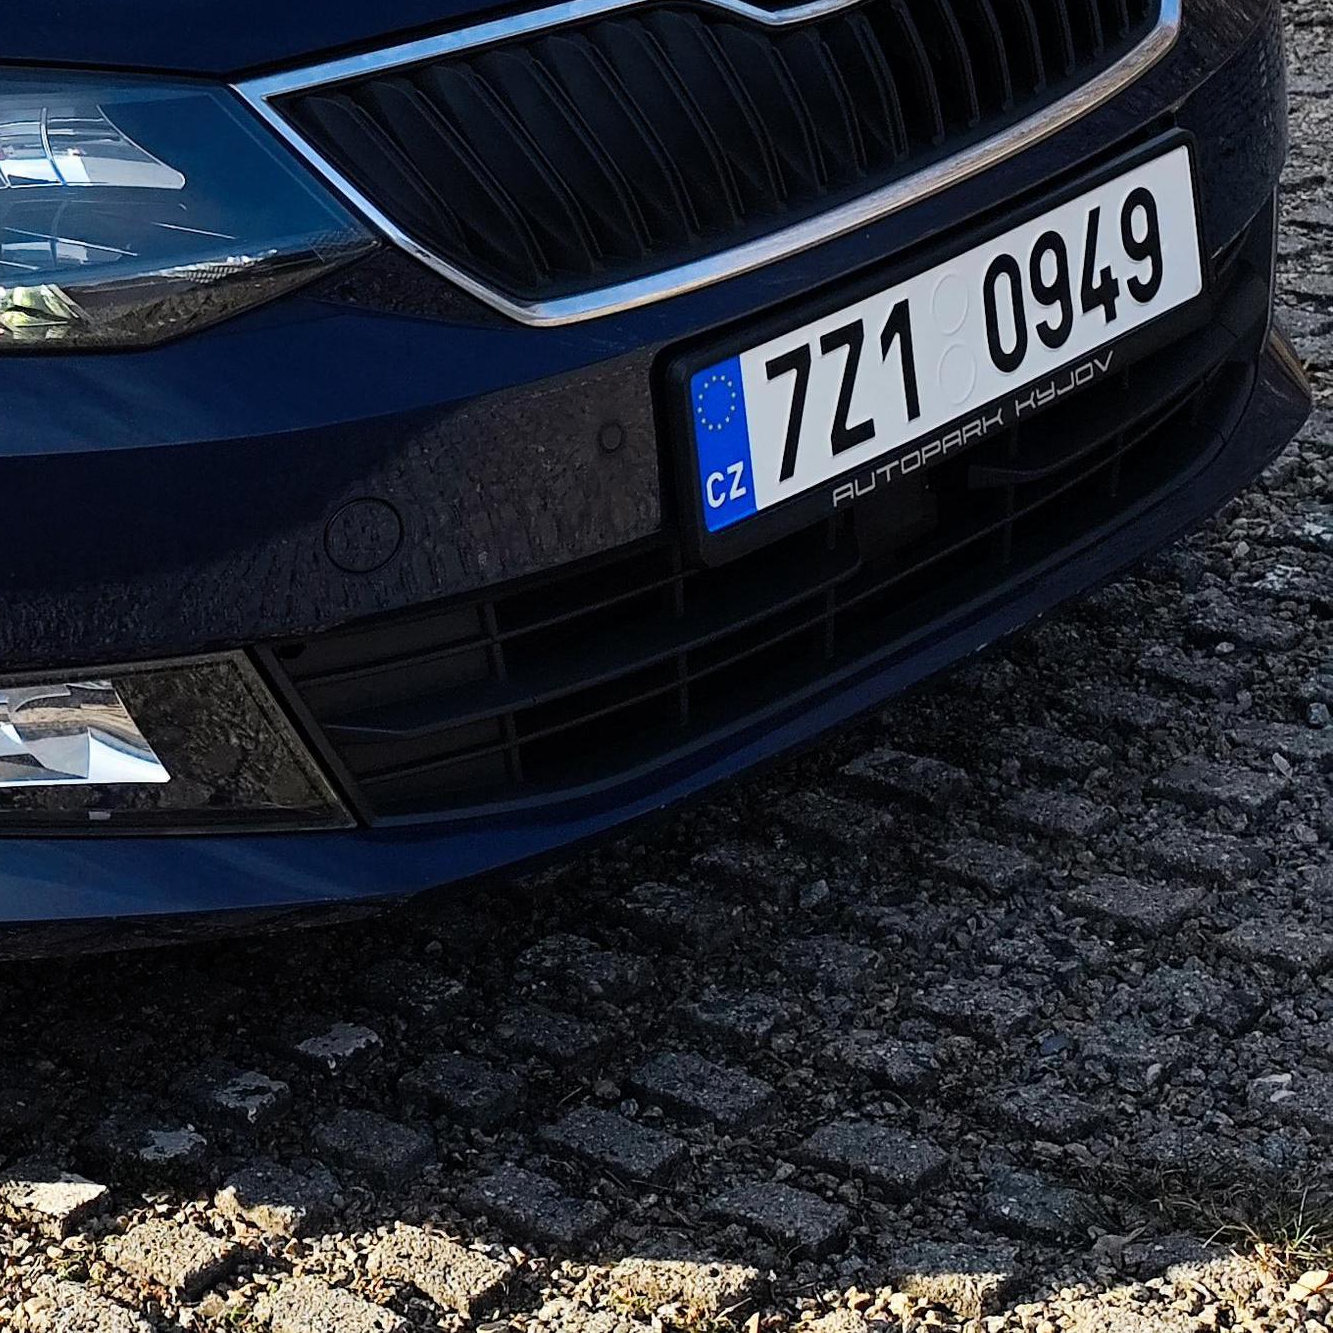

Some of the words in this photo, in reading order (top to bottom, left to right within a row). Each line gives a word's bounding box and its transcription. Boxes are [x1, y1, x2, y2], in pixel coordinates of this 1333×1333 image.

[765, 297, 921, 484] 7Z1
[982, 186, 1164, 375] 0949
[705, 461, 748, 510] CZ
[833, 407, 1005, 508] AUTOPARK
[1015, 350, 1114, 417] KYJOV
